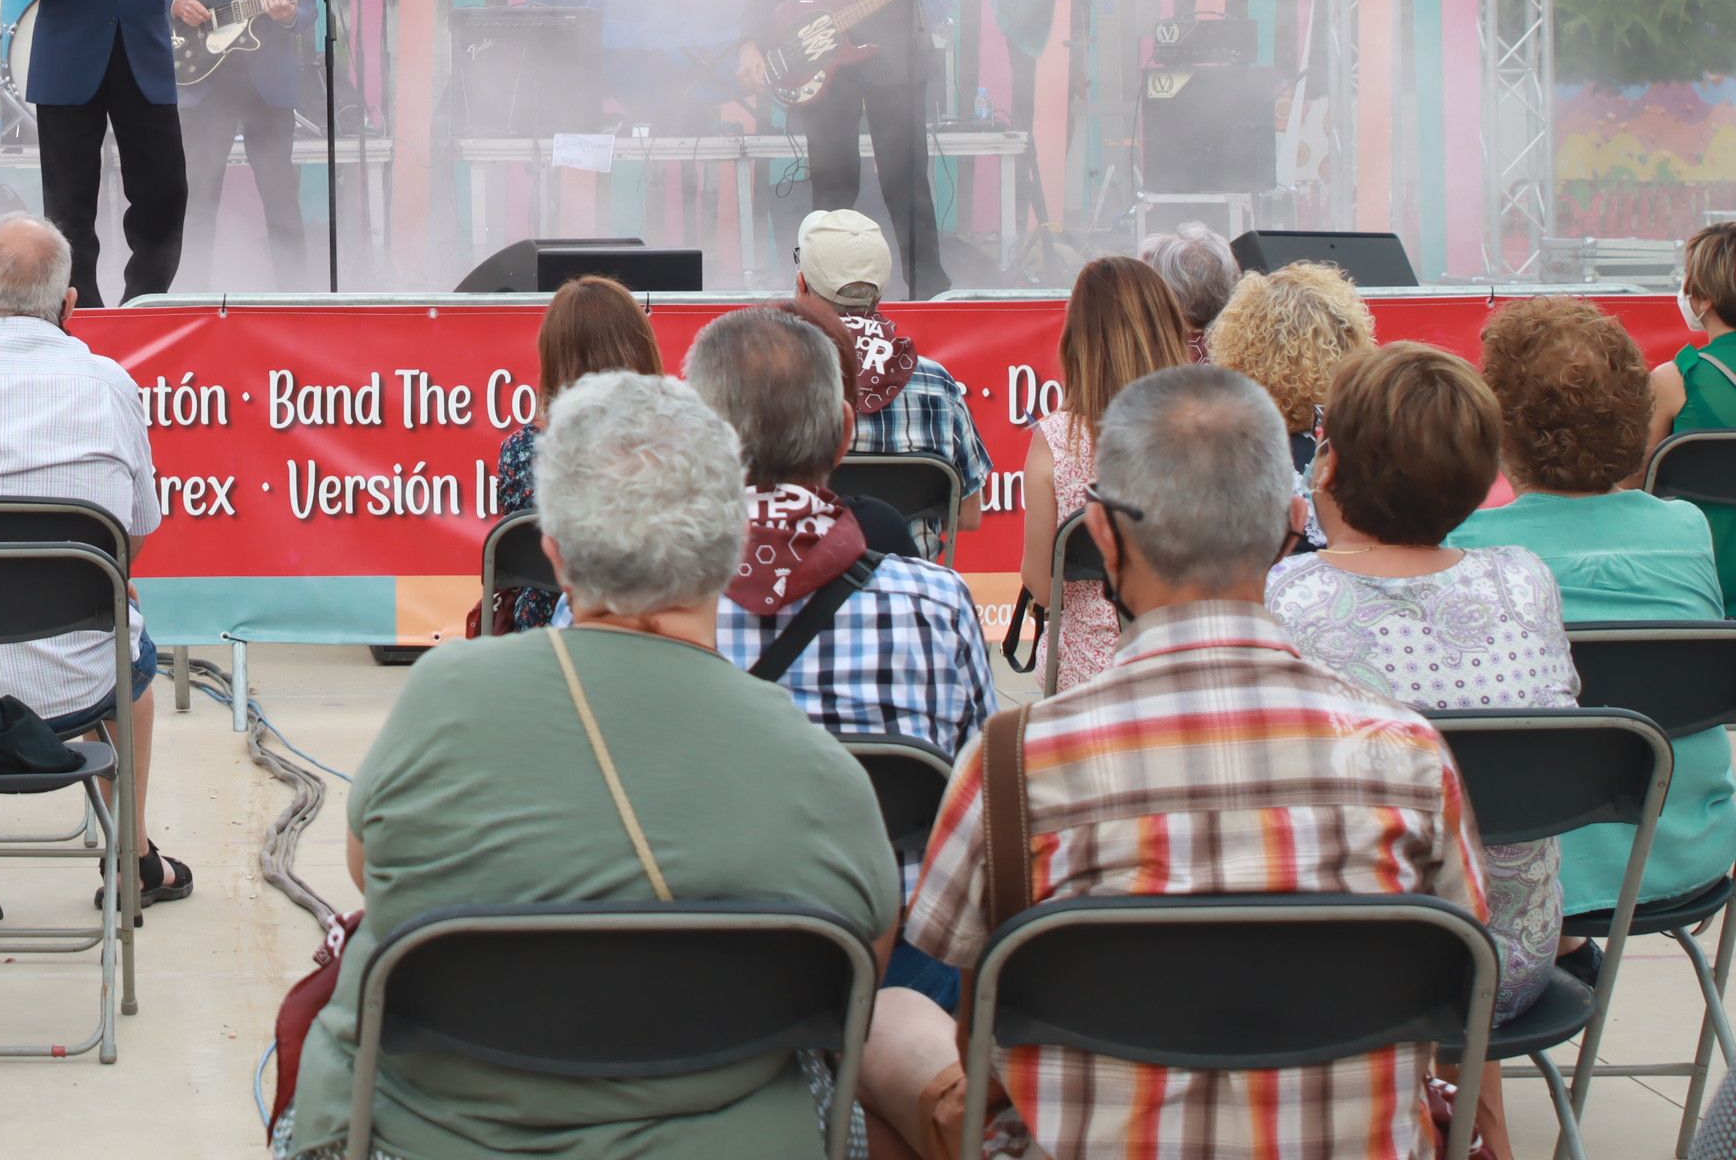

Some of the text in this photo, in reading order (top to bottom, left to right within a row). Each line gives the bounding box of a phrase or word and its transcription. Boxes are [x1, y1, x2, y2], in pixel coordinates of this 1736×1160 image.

[268, 368, 382, 430] Band
[394, 368, 473, 429] The
[486, 368, 537, 429] Co
[1007, 364, 1064, 425] Do
[151, 464, 236, 517] rex
[286, 458, 461, 520] Versión
[979, 469, 1027, 512] un
